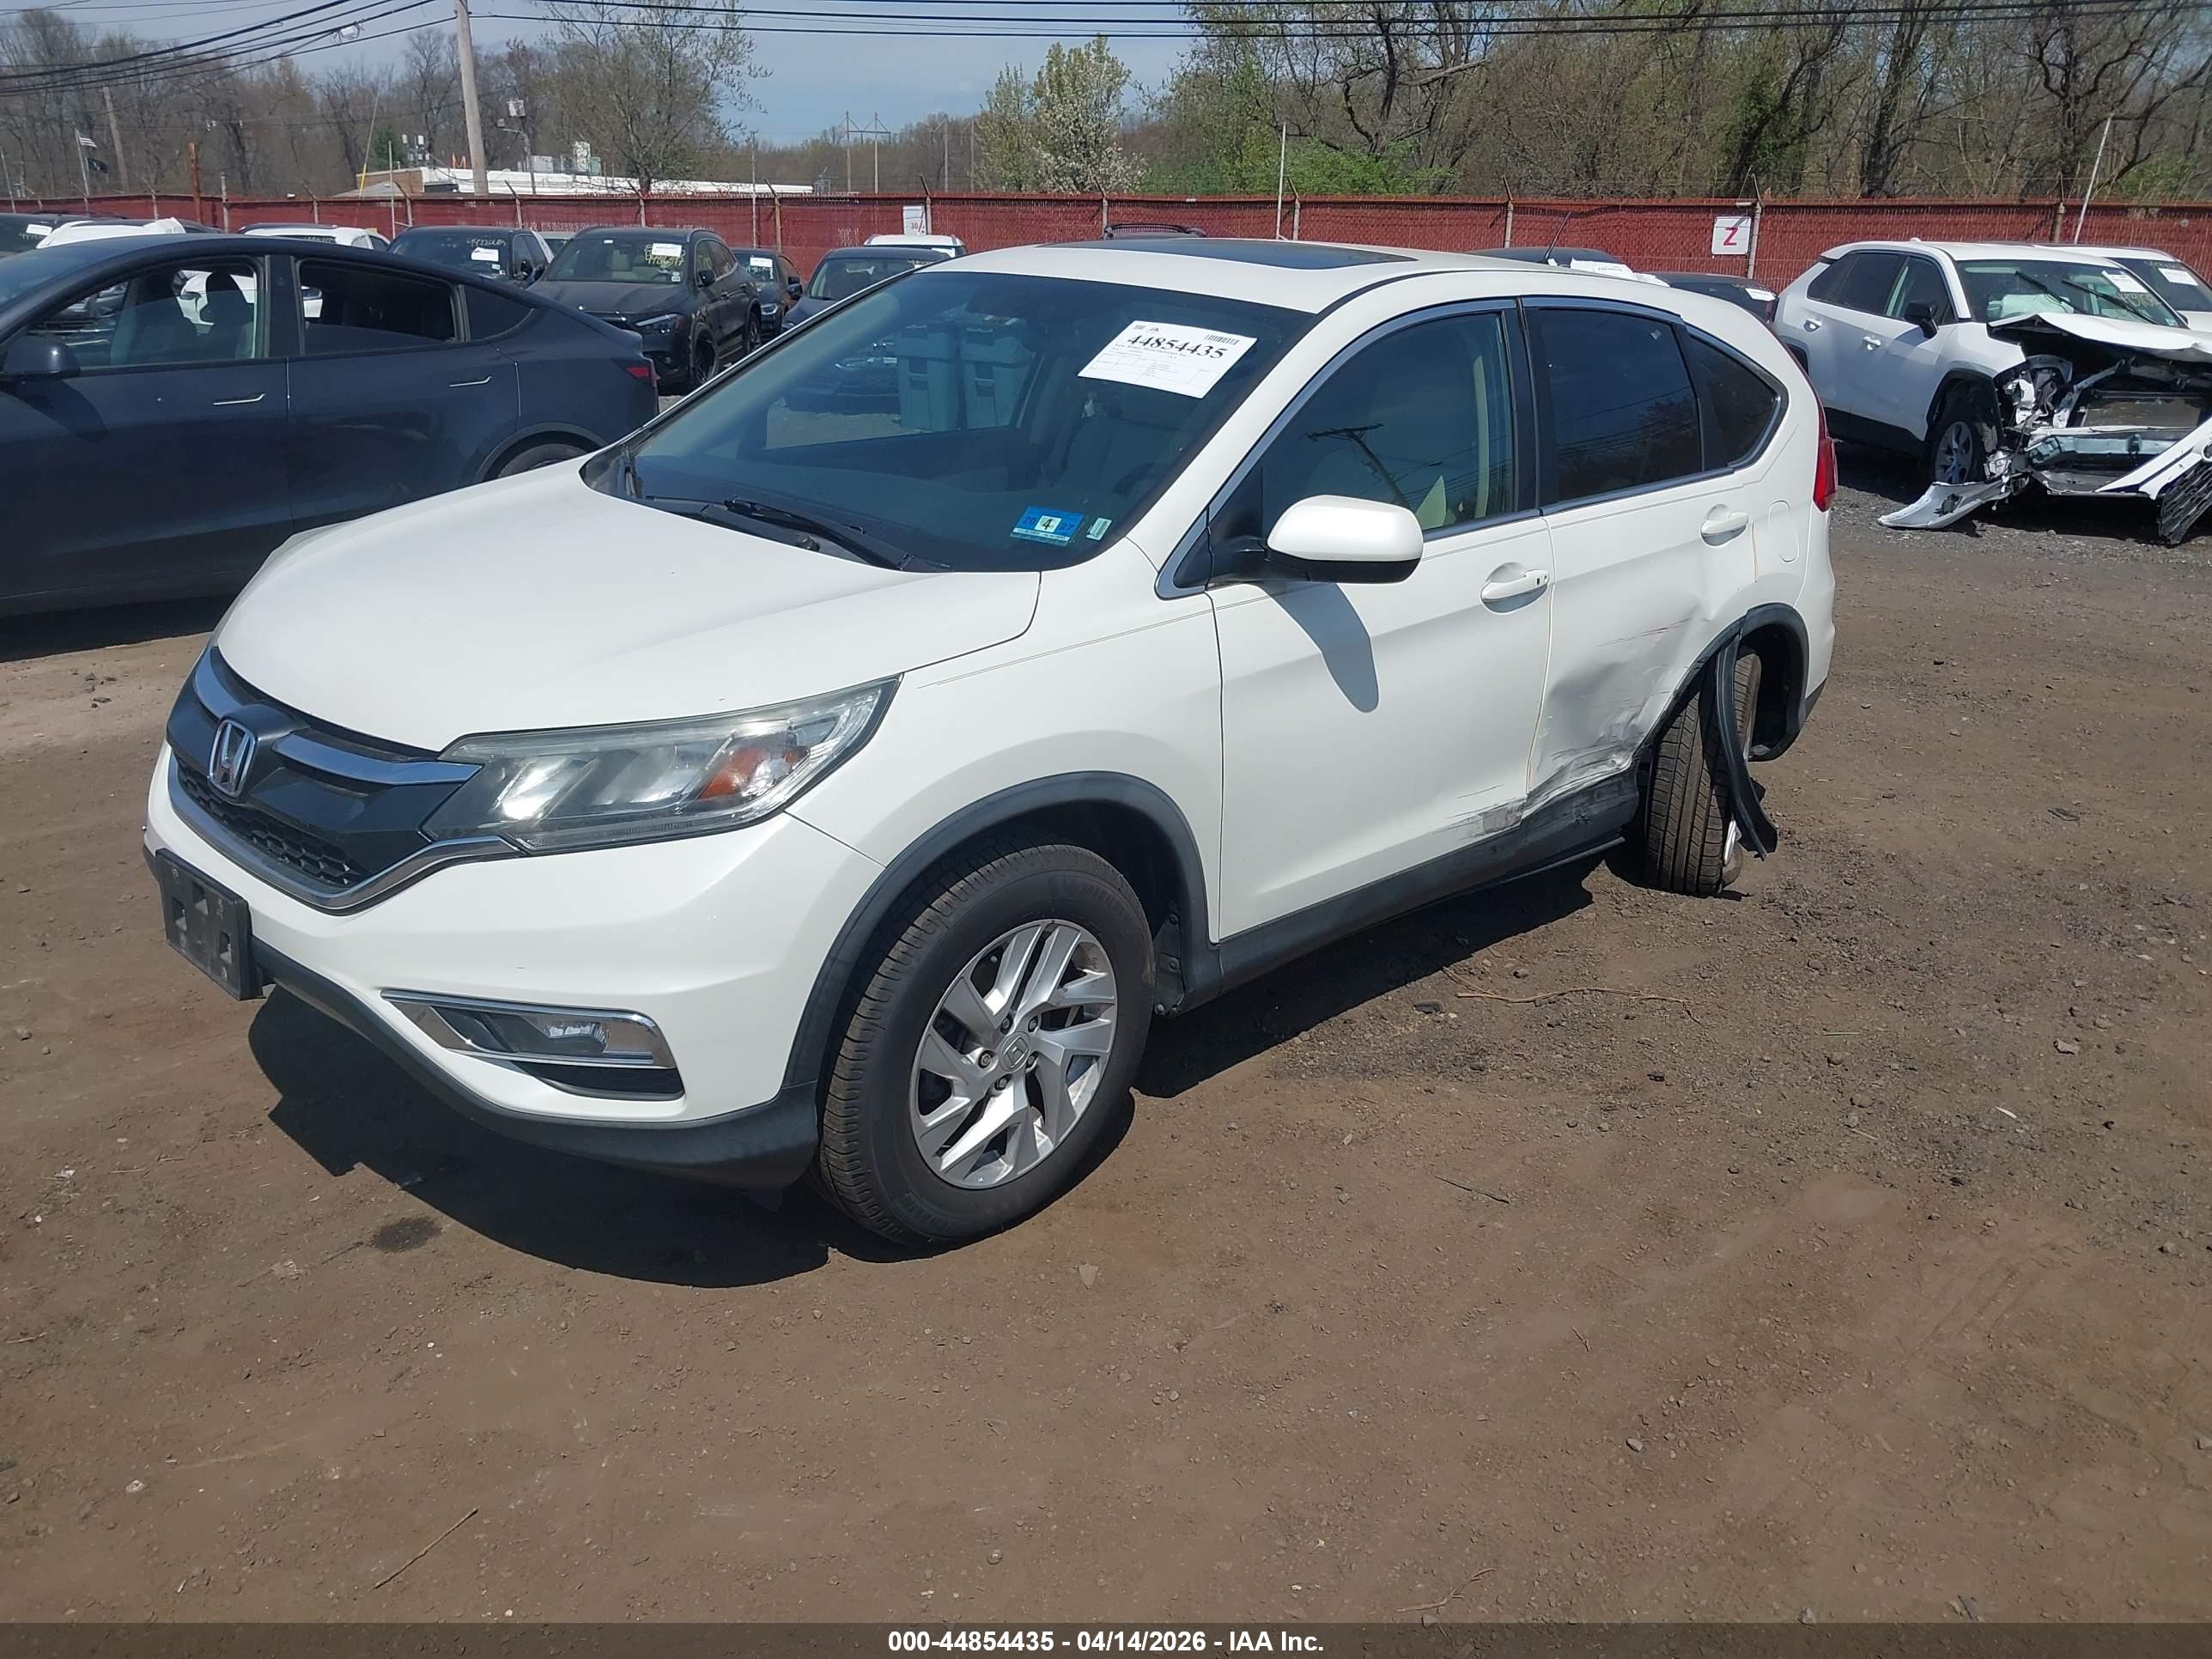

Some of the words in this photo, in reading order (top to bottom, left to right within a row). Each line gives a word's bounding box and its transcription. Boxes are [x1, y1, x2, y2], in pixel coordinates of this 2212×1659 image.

[1723, 227, 1739, 246] Z
[1127, 335, 1228, 359] 44854435
[1023, 516, 1036, 525] 20
[1042, 518, 1052, 530] 4
